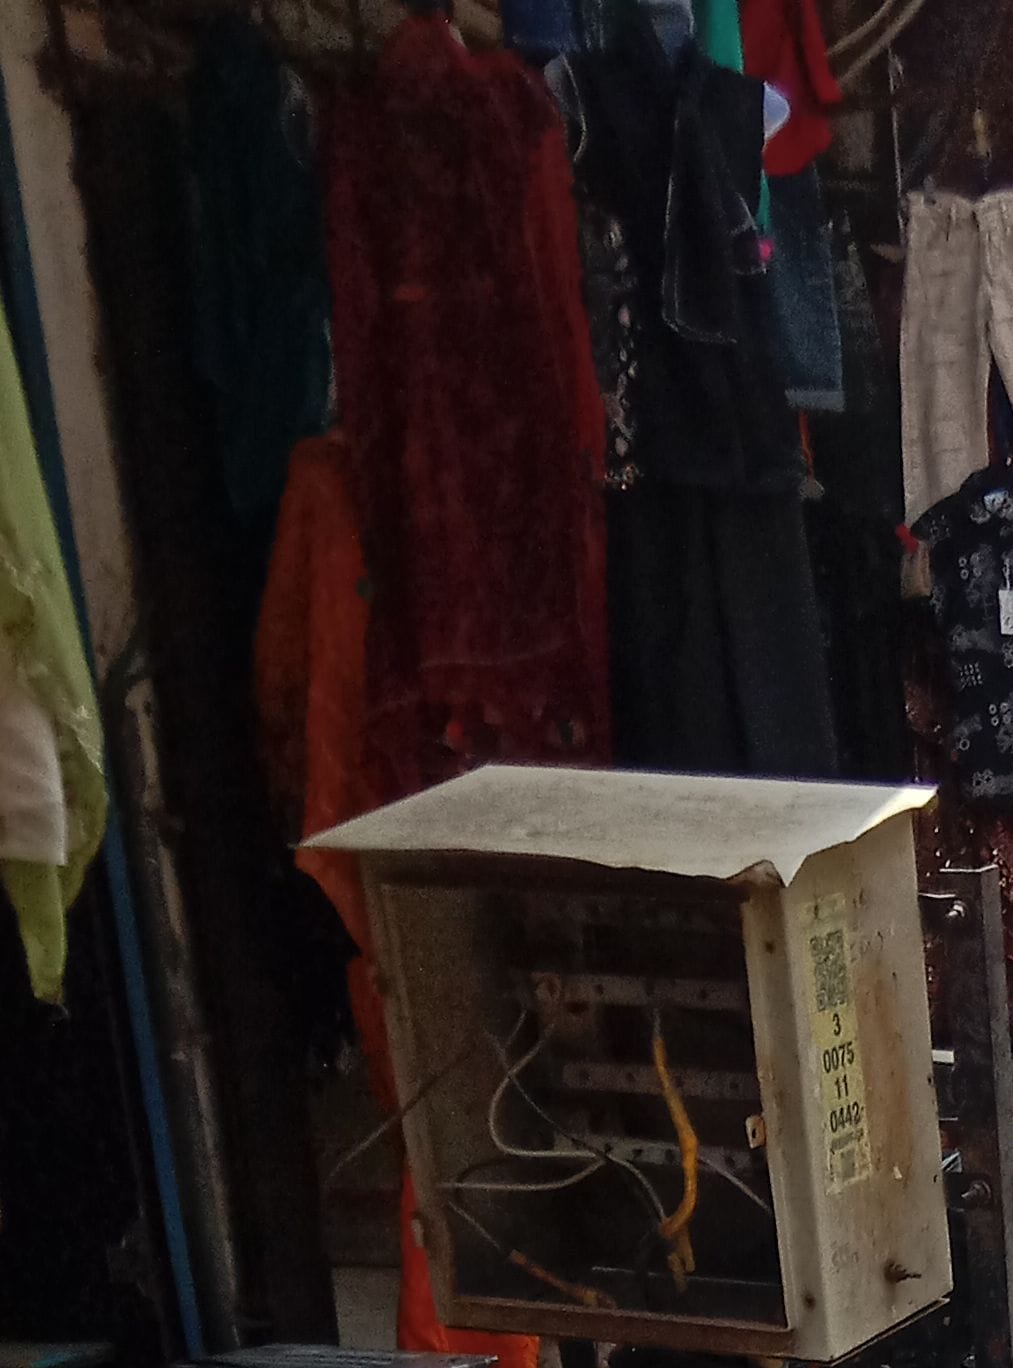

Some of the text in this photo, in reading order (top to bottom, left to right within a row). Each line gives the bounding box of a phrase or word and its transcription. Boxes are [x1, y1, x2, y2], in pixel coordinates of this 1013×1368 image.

[832, 1013, 842, 1037] 3
[822, 1041, 855, 1074] 0075
[834, 1074, 849, 1100] 11
